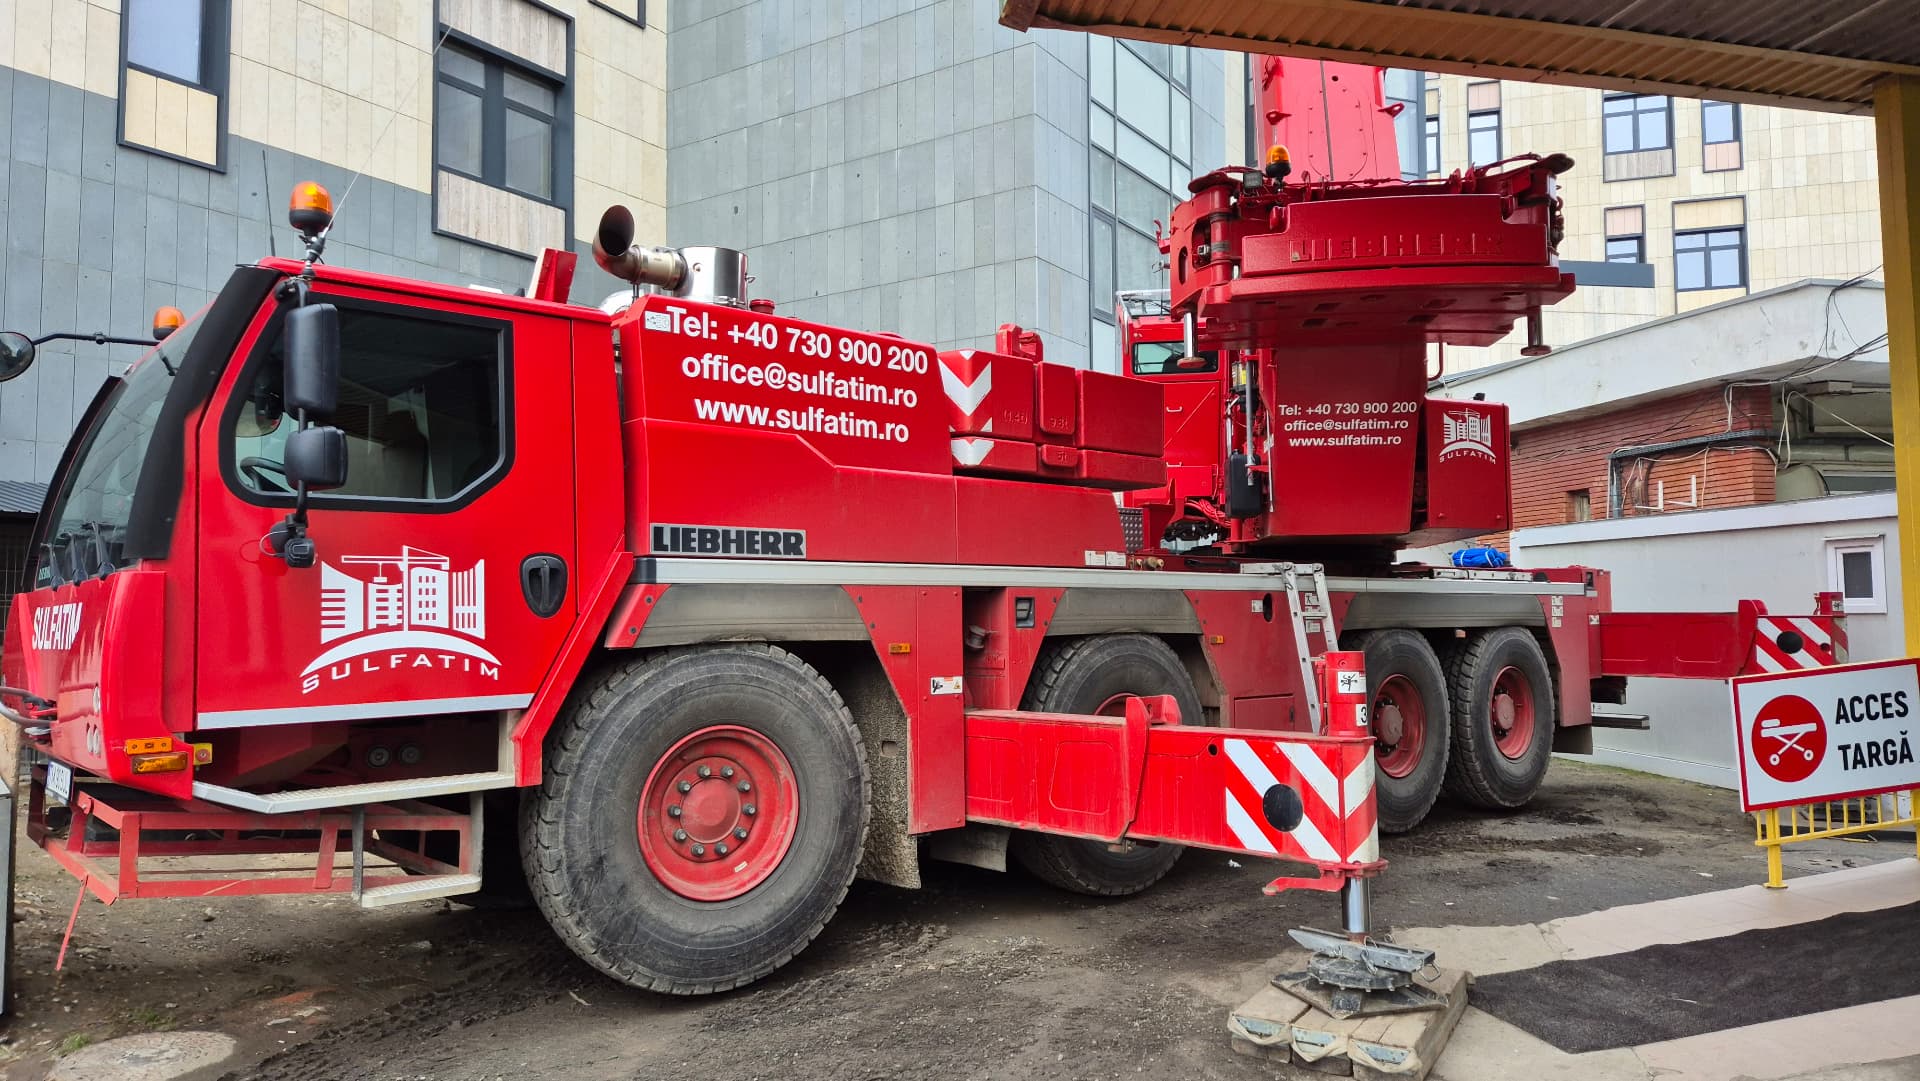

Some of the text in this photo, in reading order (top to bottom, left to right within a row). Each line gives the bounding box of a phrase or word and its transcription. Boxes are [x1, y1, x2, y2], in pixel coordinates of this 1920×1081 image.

[1290, 233, 1504, 263] LIEBHERR
[667, 306, 718, 341] Tel:
[728, 321, 778, 350] +40
[786, 328, 832, 359] 730
[839, 338, 882, 367] 900
[888, 346, 928, 376] 200
[682, 352, 918, 408] office@sulfatim.ro
[695, 398, 909, 443] www.sulfatim.ro
[1279, 401, 1417, 416] Tel: +40 730 900 200
[1284, 418, 1409, 432] office@sulfatim.ro
[1289, 434, 1402, 447] www.sulfatim.ro
[1439, 450, 1496, 465] SULFATIM
[653, 525, 804, 556] LIEBHERR
[31, 601, 83, 651] SULFATIM
[301, 653, 500, 695] SULFATIM
[1835, 690, 1909, 725] ACCES
[1837, 729, 1915, 771] TARGĂ
